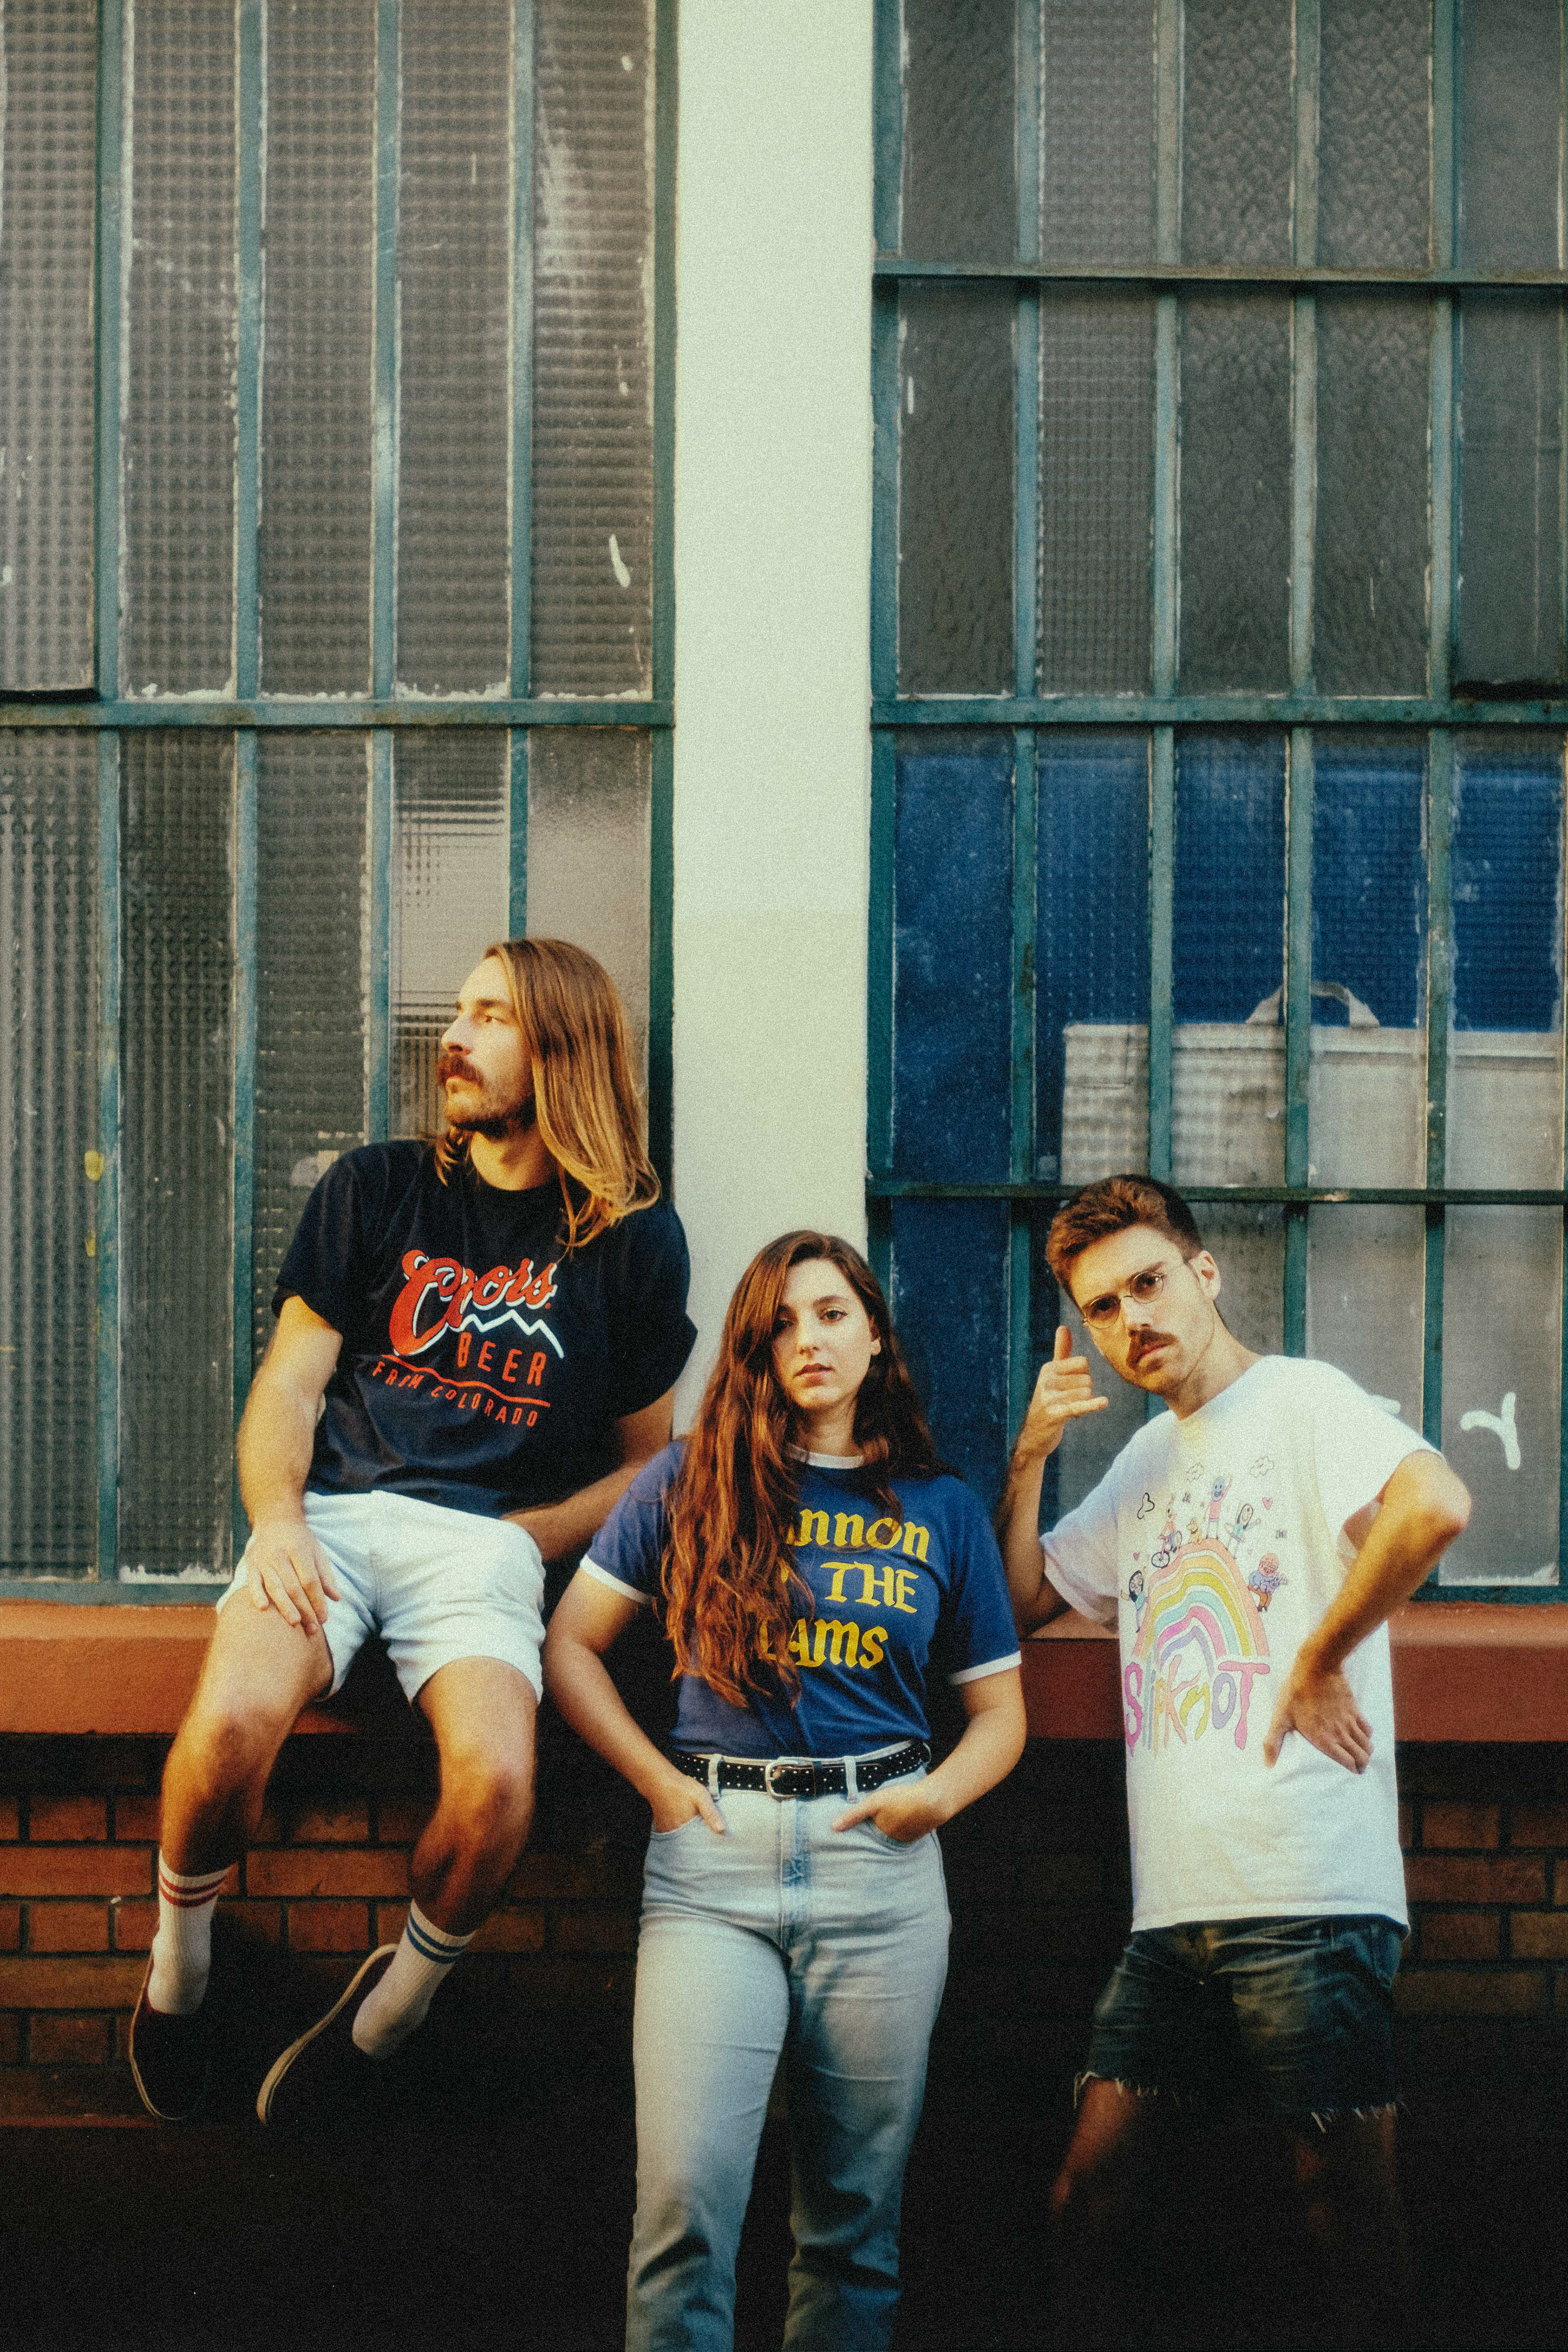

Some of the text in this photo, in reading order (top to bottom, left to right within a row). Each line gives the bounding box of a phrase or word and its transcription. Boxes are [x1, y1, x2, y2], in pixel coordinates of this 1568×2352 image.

[389, 1249, 558, 1356] Coors
[457, 1332, 547, 1386] BEER
[372, 1361, 538, 1427] FROM COLORADO
[785, 1509, 930, 1562] nnon
[820, 1561, 919, 1613] THE
